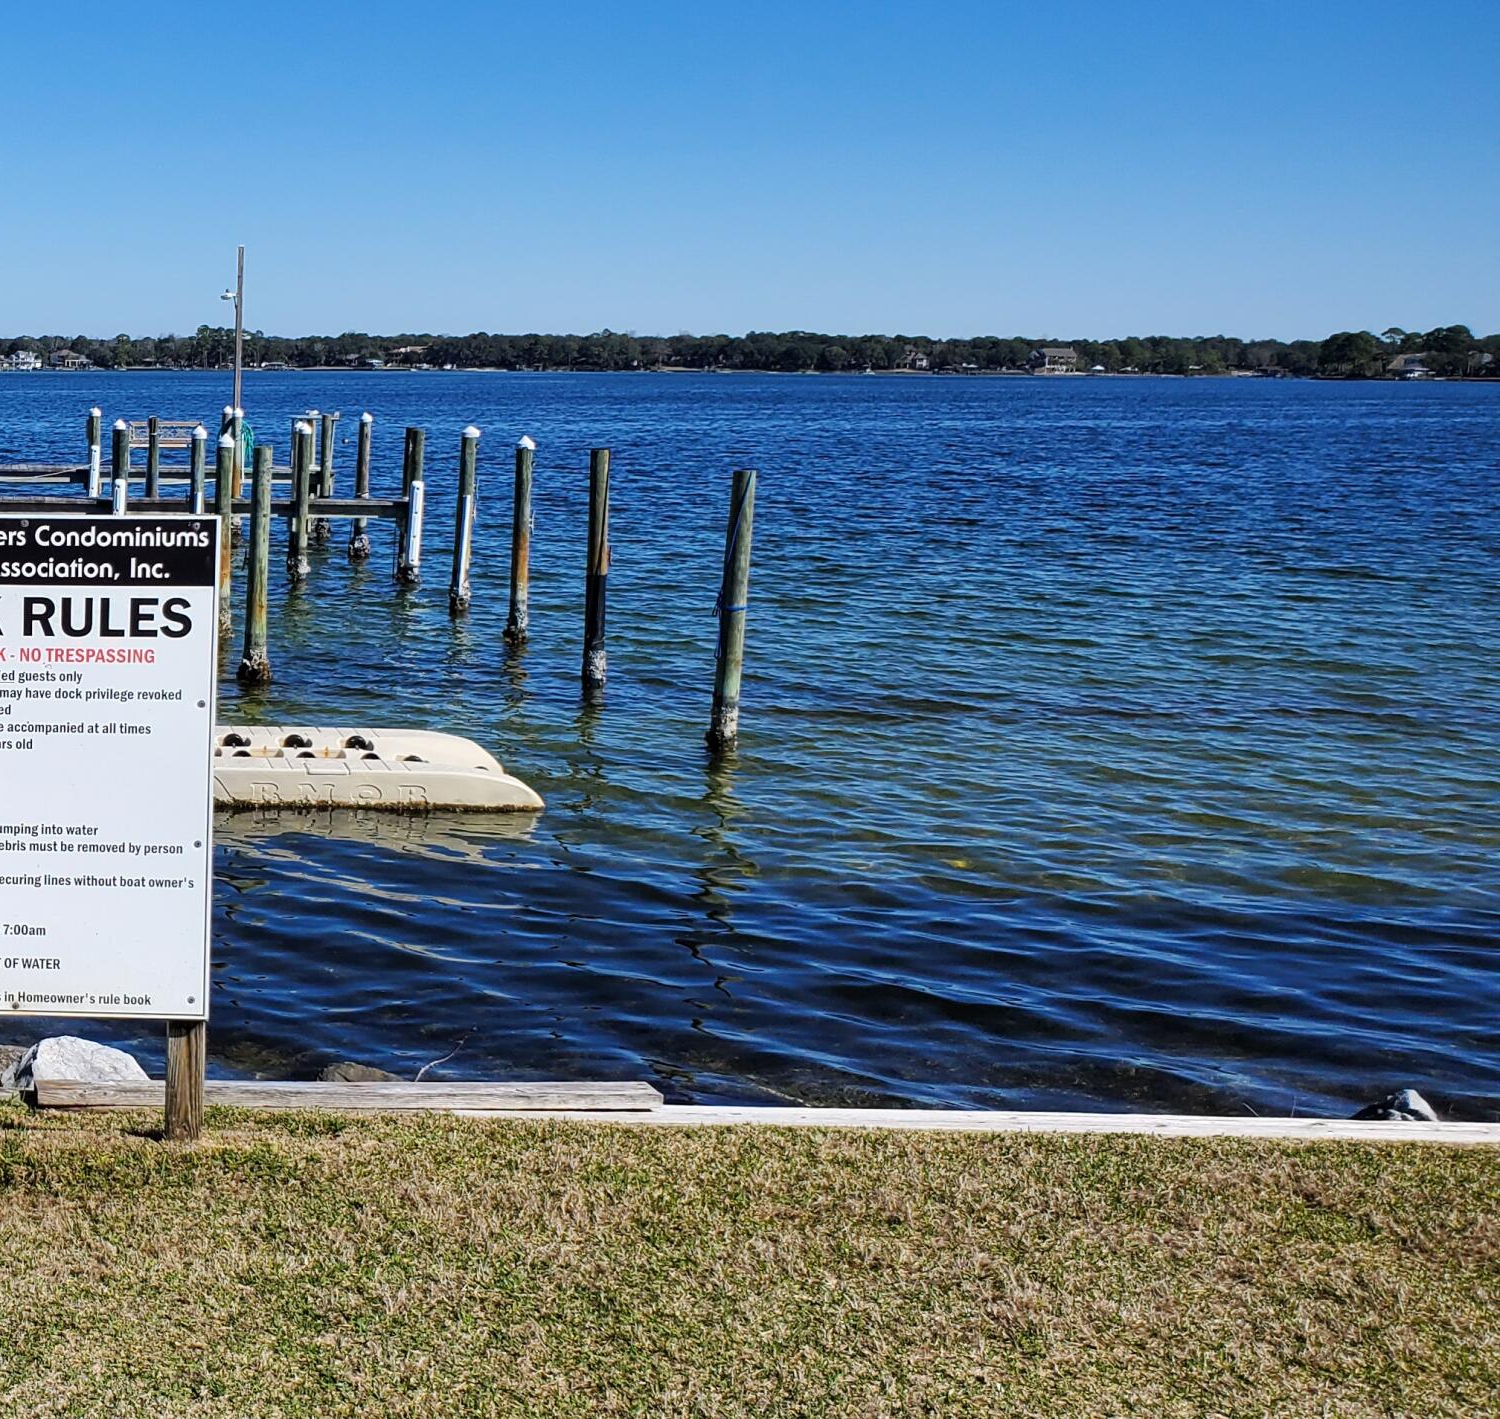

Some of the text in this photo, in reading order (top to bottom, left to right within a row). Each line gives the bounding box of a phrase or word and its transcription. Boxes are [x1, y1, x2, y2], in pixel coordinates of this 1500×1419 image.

[34, 525, 210, 548] Condominiums
[129, 556, 170, 579] Inc.
[22, 596, 193, 639] RULES
[19, 647, 42, 663] NO
[46, 648, 156, 664] TRESPASSING
[17, 670, 57, 684] guests
[58, 670, 83, 685] only
[24, 686, 52, 699] have
[53, 687, 83, 700] dock
[84, 687, 134, 703] privilege
[136, 688, 182, 701] revoked
[6, 720, 84, 736] accompanied
[86, 722, 100, 734] at
[101, 722, 117, 734] all
[118, 722, 152, 735] times
[14, 737, 33, 750] old
[40, 823, 63, 835] into
[65, 824, 99, 836] water
[28, 840, 58, 852] must
[59, 840, 74, 853] be
[76, 841, 126, 853] removed
[128, 841, 142, 856] by
[143, 844, 183, 856] person
[43, 873, 72, 886] lines
[73, 874, 117, 887] without
[119, 875, 146, 888] boat
[147, 876, 195, 889] owner's
[2, 923, 46, 936] 7:00am
[3, 957, 20, 969] OF
[20, 957, 61, 970] WATER
[3, 991, 15, 1003] in
[17, 991, 96, 1005] Homeowner's
[97, 992, 121, 1005] rule
[122, 993, 152, 1006] book
